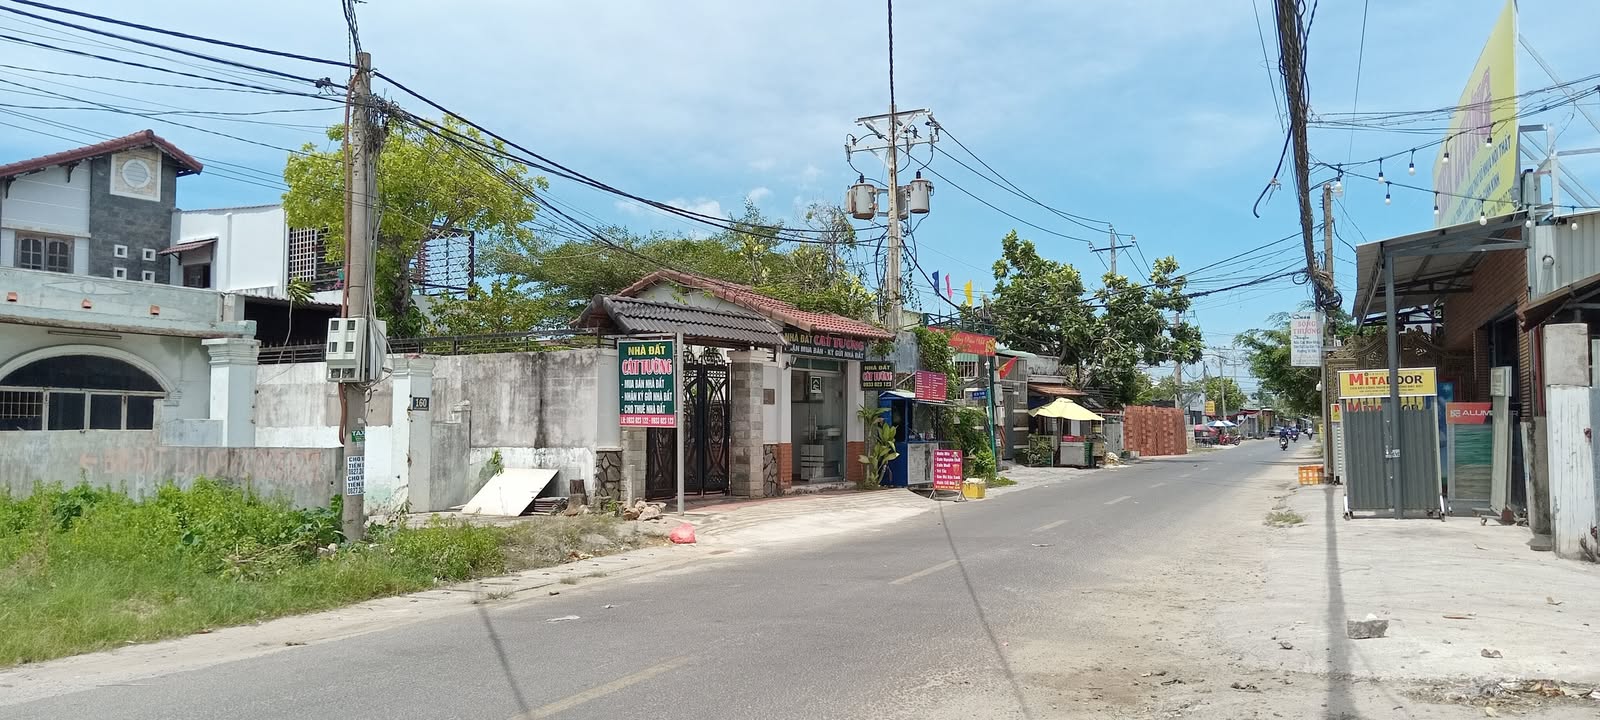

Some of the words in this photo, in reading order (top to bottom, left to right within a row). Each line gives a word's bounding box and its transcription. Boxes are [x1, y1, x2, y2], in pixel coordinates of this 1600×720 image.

[784, 332, 798, 343] NHÀ
[628, 344, 646, 355] NHÀ
[648, 343, 666, 355] ĐẤT
[813, 347, 824, 355] BÁN
[827, 348, 834, 356] KÝ
[844, 350, 854, 358] NHÀ
[855, 351, 864, 359] ĐẤT
[622, 357, 640, 375] CÁT
[641, 356, 672, 375] TƯỜNG
[624, 379, 634, 388] MUA
[635, 377, 645, 388] BÁN
[645, 377, 655, 388] NHÀ
[656, 376, 664, 388] ĐẤT
[624, 390, 637, 403] NHẬN
[638, 390, 644, 401] KÝ
[653, 390, 662, 401] NHÀ
[663, 389, 672, 401] ĐẤT
[415, 398, 427, 408] 160
[624, 404, 634, 414] CHO
[634, 403, 646, 414] THUÊ
[646, 403, 656, 414] NHÀ
[656, 402, 666, 414] ĐẤT
